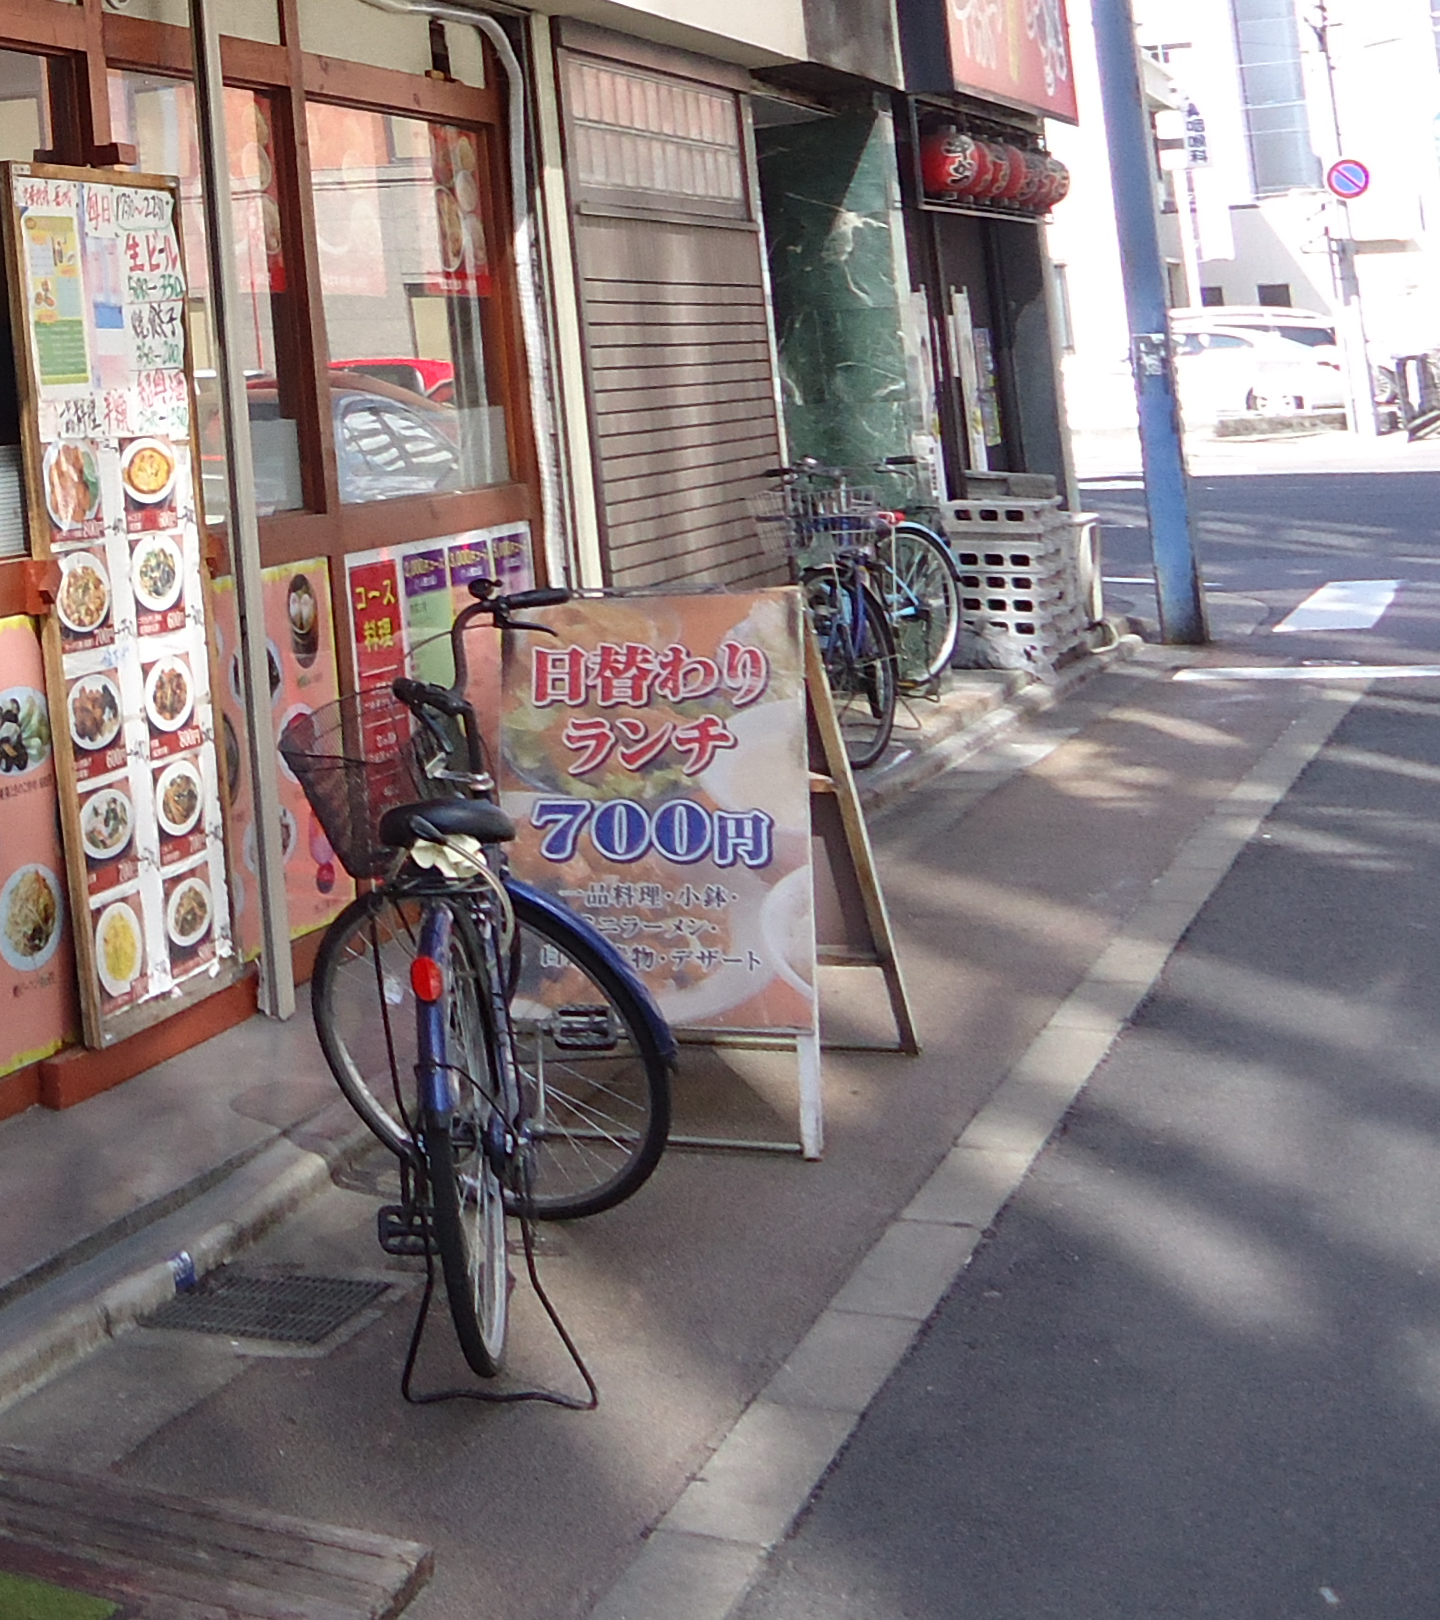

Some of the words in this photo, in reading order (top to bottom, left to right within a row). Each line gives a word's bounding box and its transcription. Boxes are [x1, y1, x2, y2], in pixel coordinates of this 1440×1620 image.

[125, 230, 179, 272] 生ビール
[355, 579, 395, 610] コース
[363, 618, 395, 652] 料理
[532, 641, 769, 708] 日替わり
[563, 717, 737, 775] ランチ
[531, 799, 773, 866] 700円
[584, 914, 719, 938] ニラーメン・
